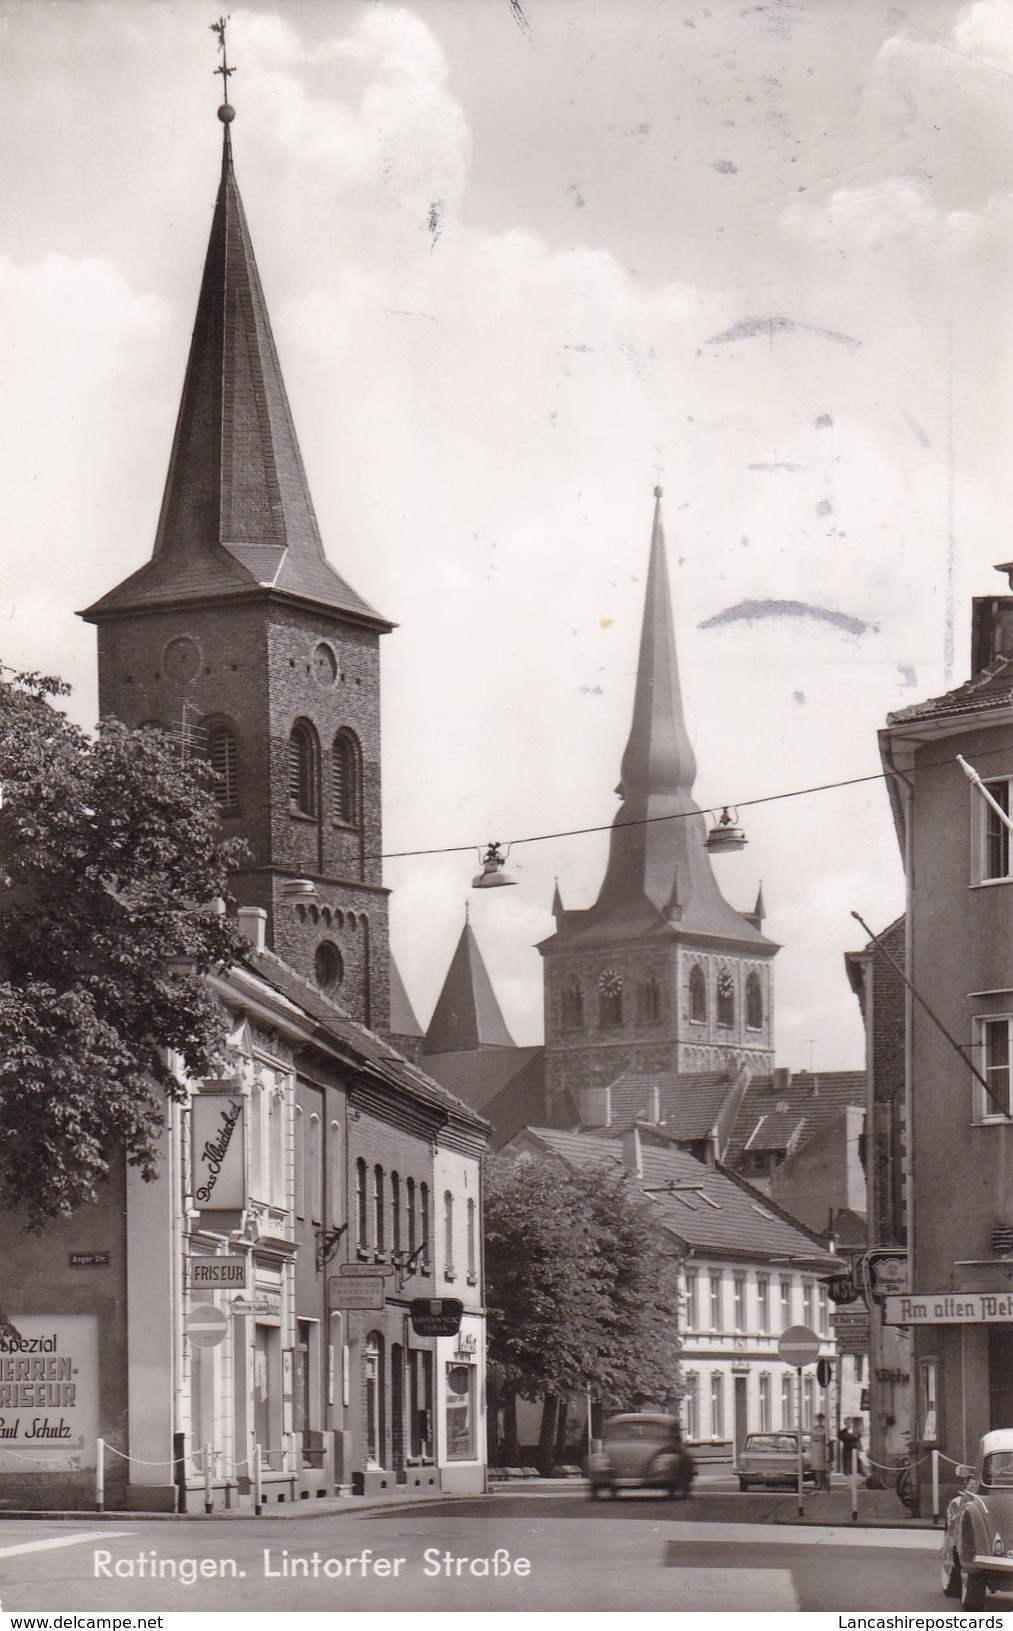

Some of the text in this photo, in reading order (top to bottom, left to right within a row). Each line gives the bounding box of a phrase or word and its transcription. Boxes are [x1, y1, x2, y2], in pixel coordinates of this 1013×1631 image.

[196, 1174, 218, 1202] Das
[194, 1266, 244, 1282] FRISEUR
[901, 1298, 927, 1321] Am
[934, 1298, 975, 1318] alten
[0, 1334, 57, 1354] Spezial
[0, 1357, 78, 1381] ERREN-
[25, 1417, 71, 1438] Schulz
